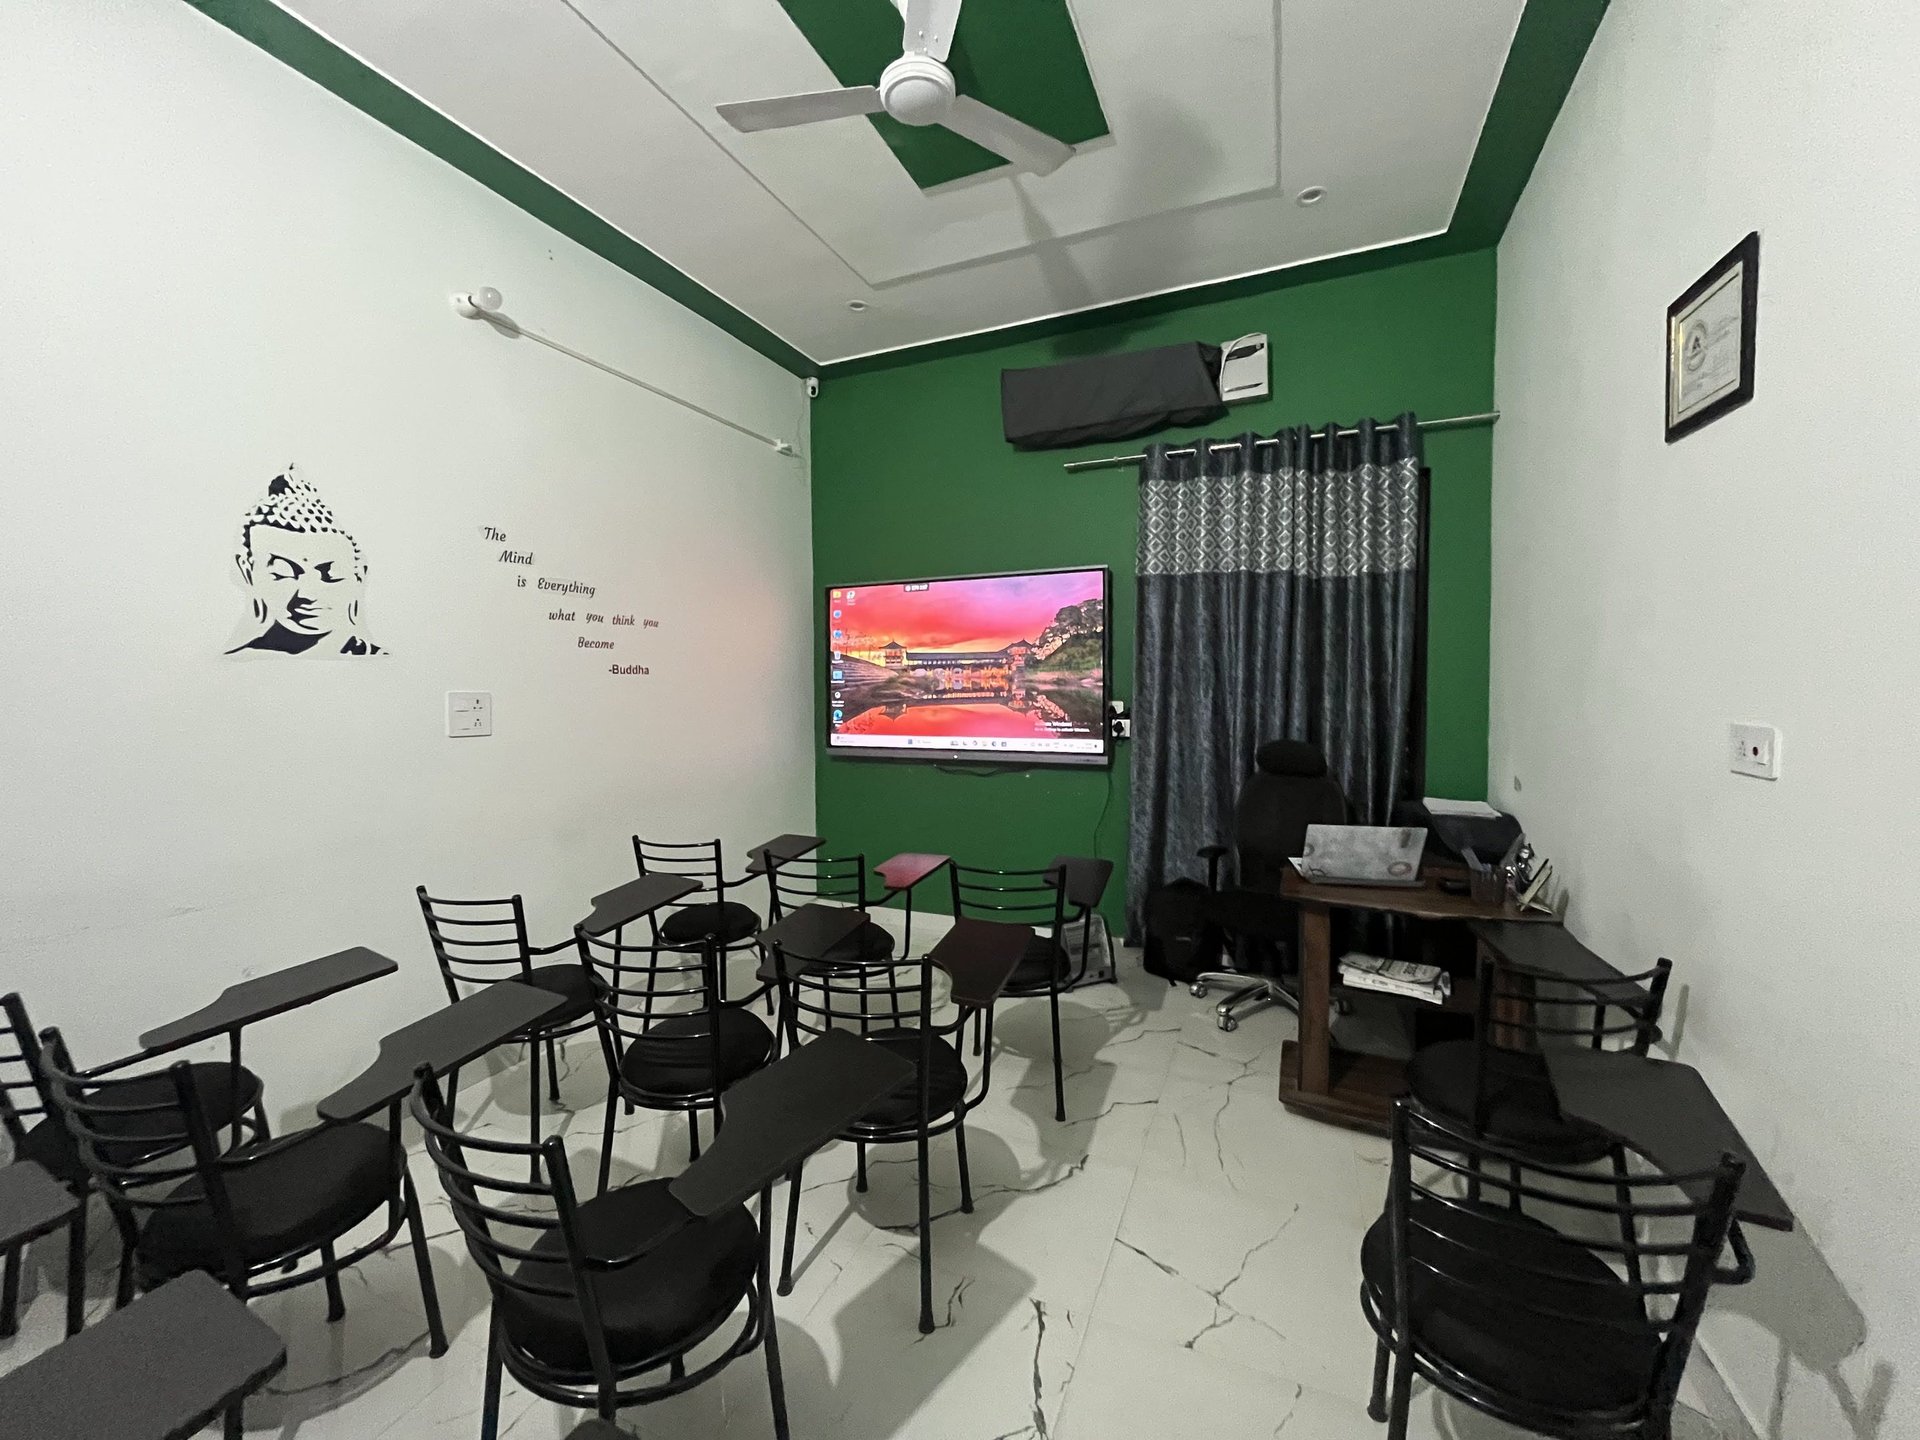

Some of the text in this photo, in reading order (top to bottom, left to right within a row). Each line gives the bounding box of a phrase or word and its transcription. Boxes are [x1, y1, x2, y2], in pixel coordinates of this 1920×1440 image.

[484, 526, 507, 542] The
[498, 550, 534, 565] Mind
[517, 575, 596, 598] is Everything
[548, 608, 659, 629] what you think you
[577, 636, 615, 649] Become
[608, 664, 650, 675] -Buddha
